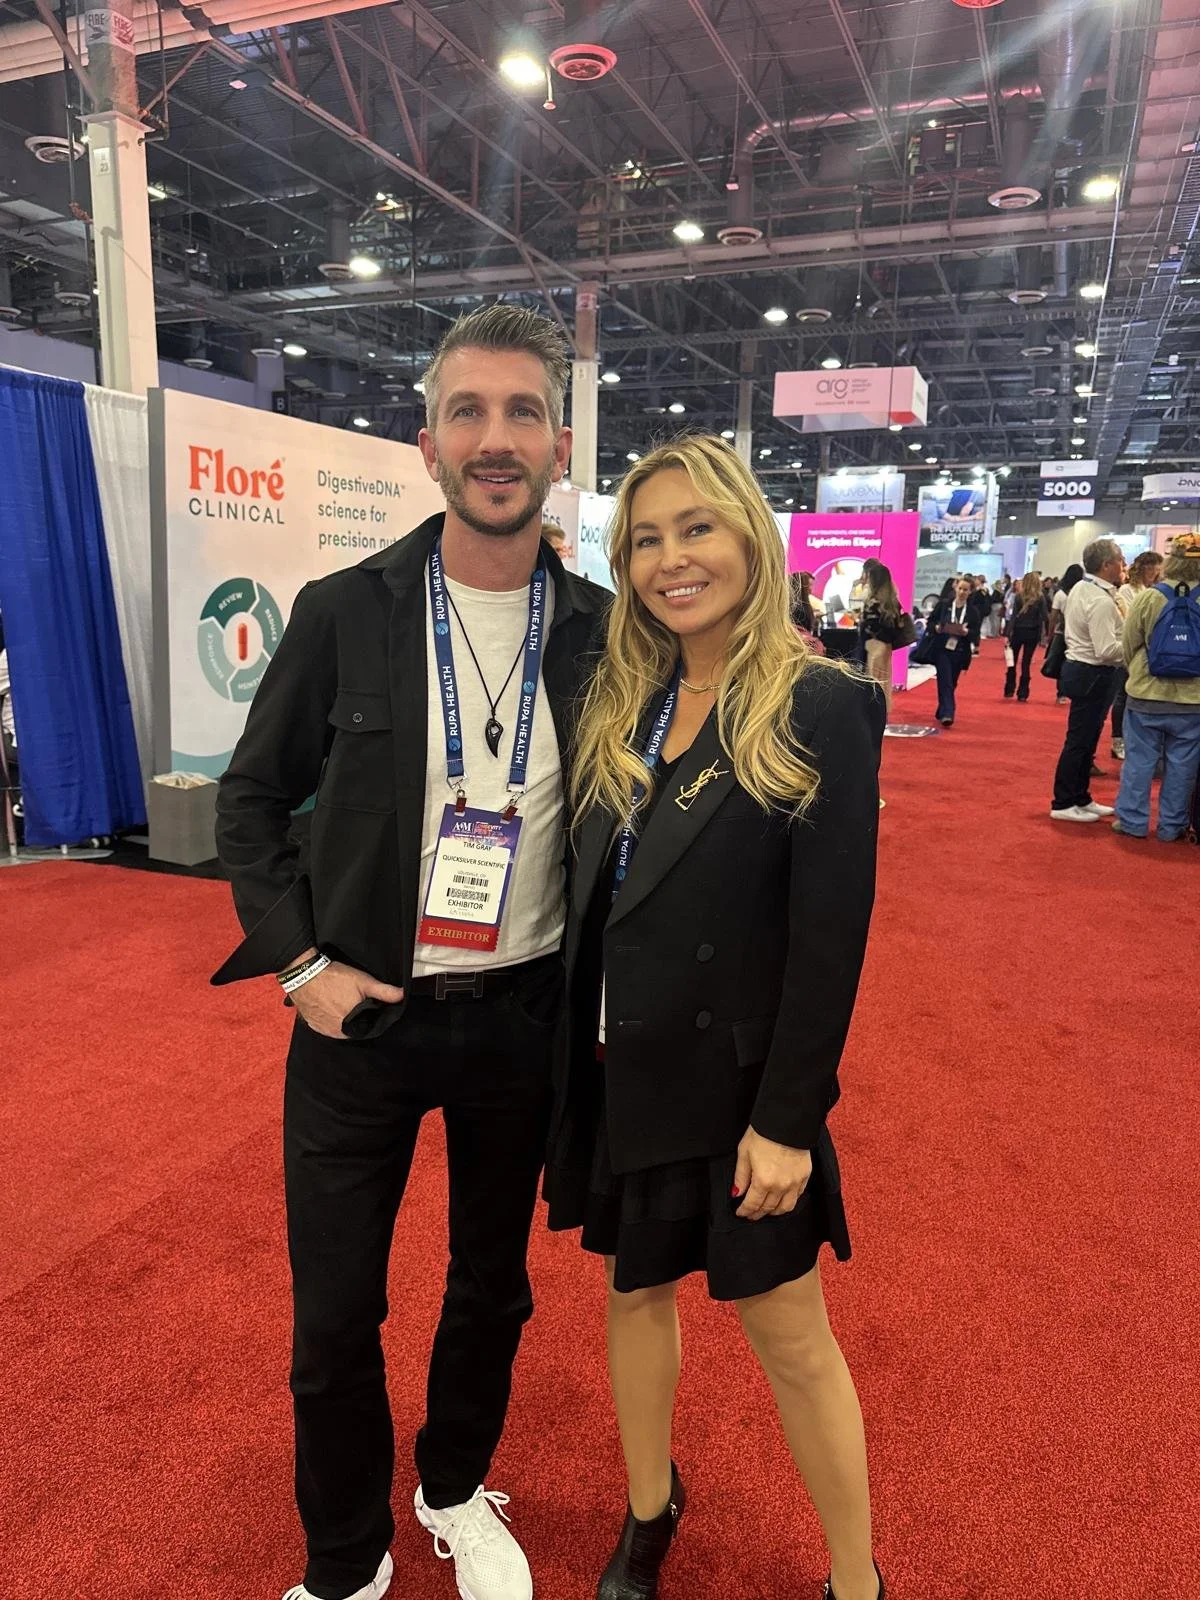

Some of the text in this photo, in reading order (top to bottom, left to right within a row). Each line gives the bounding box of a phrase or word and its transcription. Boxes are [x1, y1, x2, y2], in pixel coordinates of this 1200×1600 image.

[816, 378, 849, 399] arg
[188, 444, 285, 501] Floré
[1043, 481, 1092, 496] 5000
[188, 497, 285, 525] CLINICAL
[317, 500, 387, 523] science for
[318, 530, 376, 550] precision
[930, 533, 980, 542] BRIGHTER
[432, 553, 446, 620] RUPA HEALTH
[528, 582, 542, 651] RUPA HEALTH
[442, 665, 459, 736] RUPA HEALTH
[515, 695, 531, 764] RUPA HEALTH
[648, 692, 675, 755] RUPA HEALTH
[463, 841, 475, 849] TIM
[619, 840, 631, 866] RUPA
[442, 854, 506, 870] QUICKSILVER SCIENTIFIC
[447, 899, 484, 911] EXHIBITOR
[427, 926, 491, 943] EXHIBITOR
